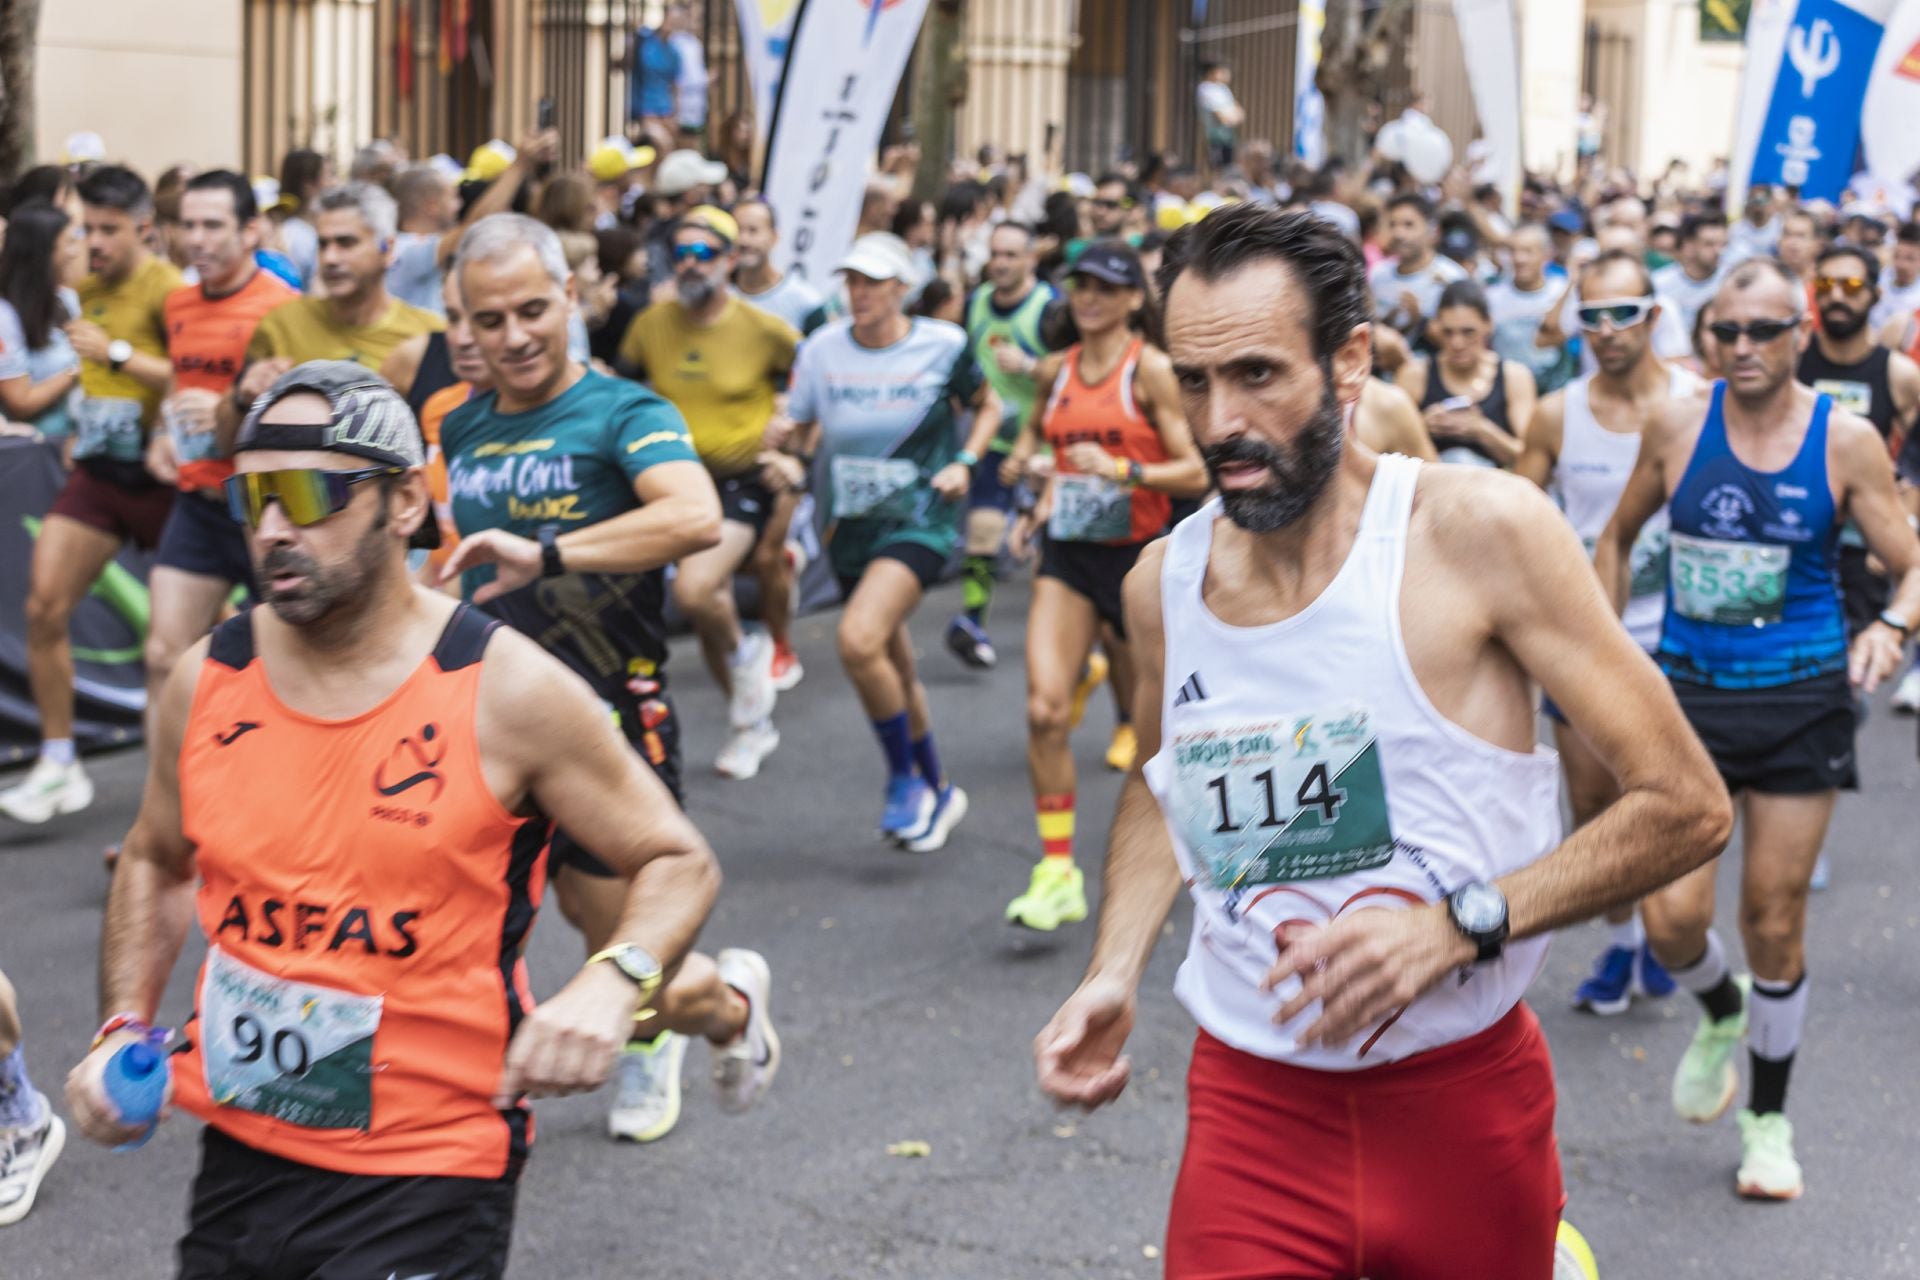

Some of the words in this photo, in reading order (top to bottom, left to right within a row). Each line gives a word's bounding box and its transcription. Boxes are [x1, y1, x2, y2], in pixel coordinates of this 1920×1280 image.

[1676, 561, 1781, 605] 3533
[1207, 761, 1343, 836] 114
[216, 895, 421, 958] ASFAS
[231, 1012, 311, 1078] 90
